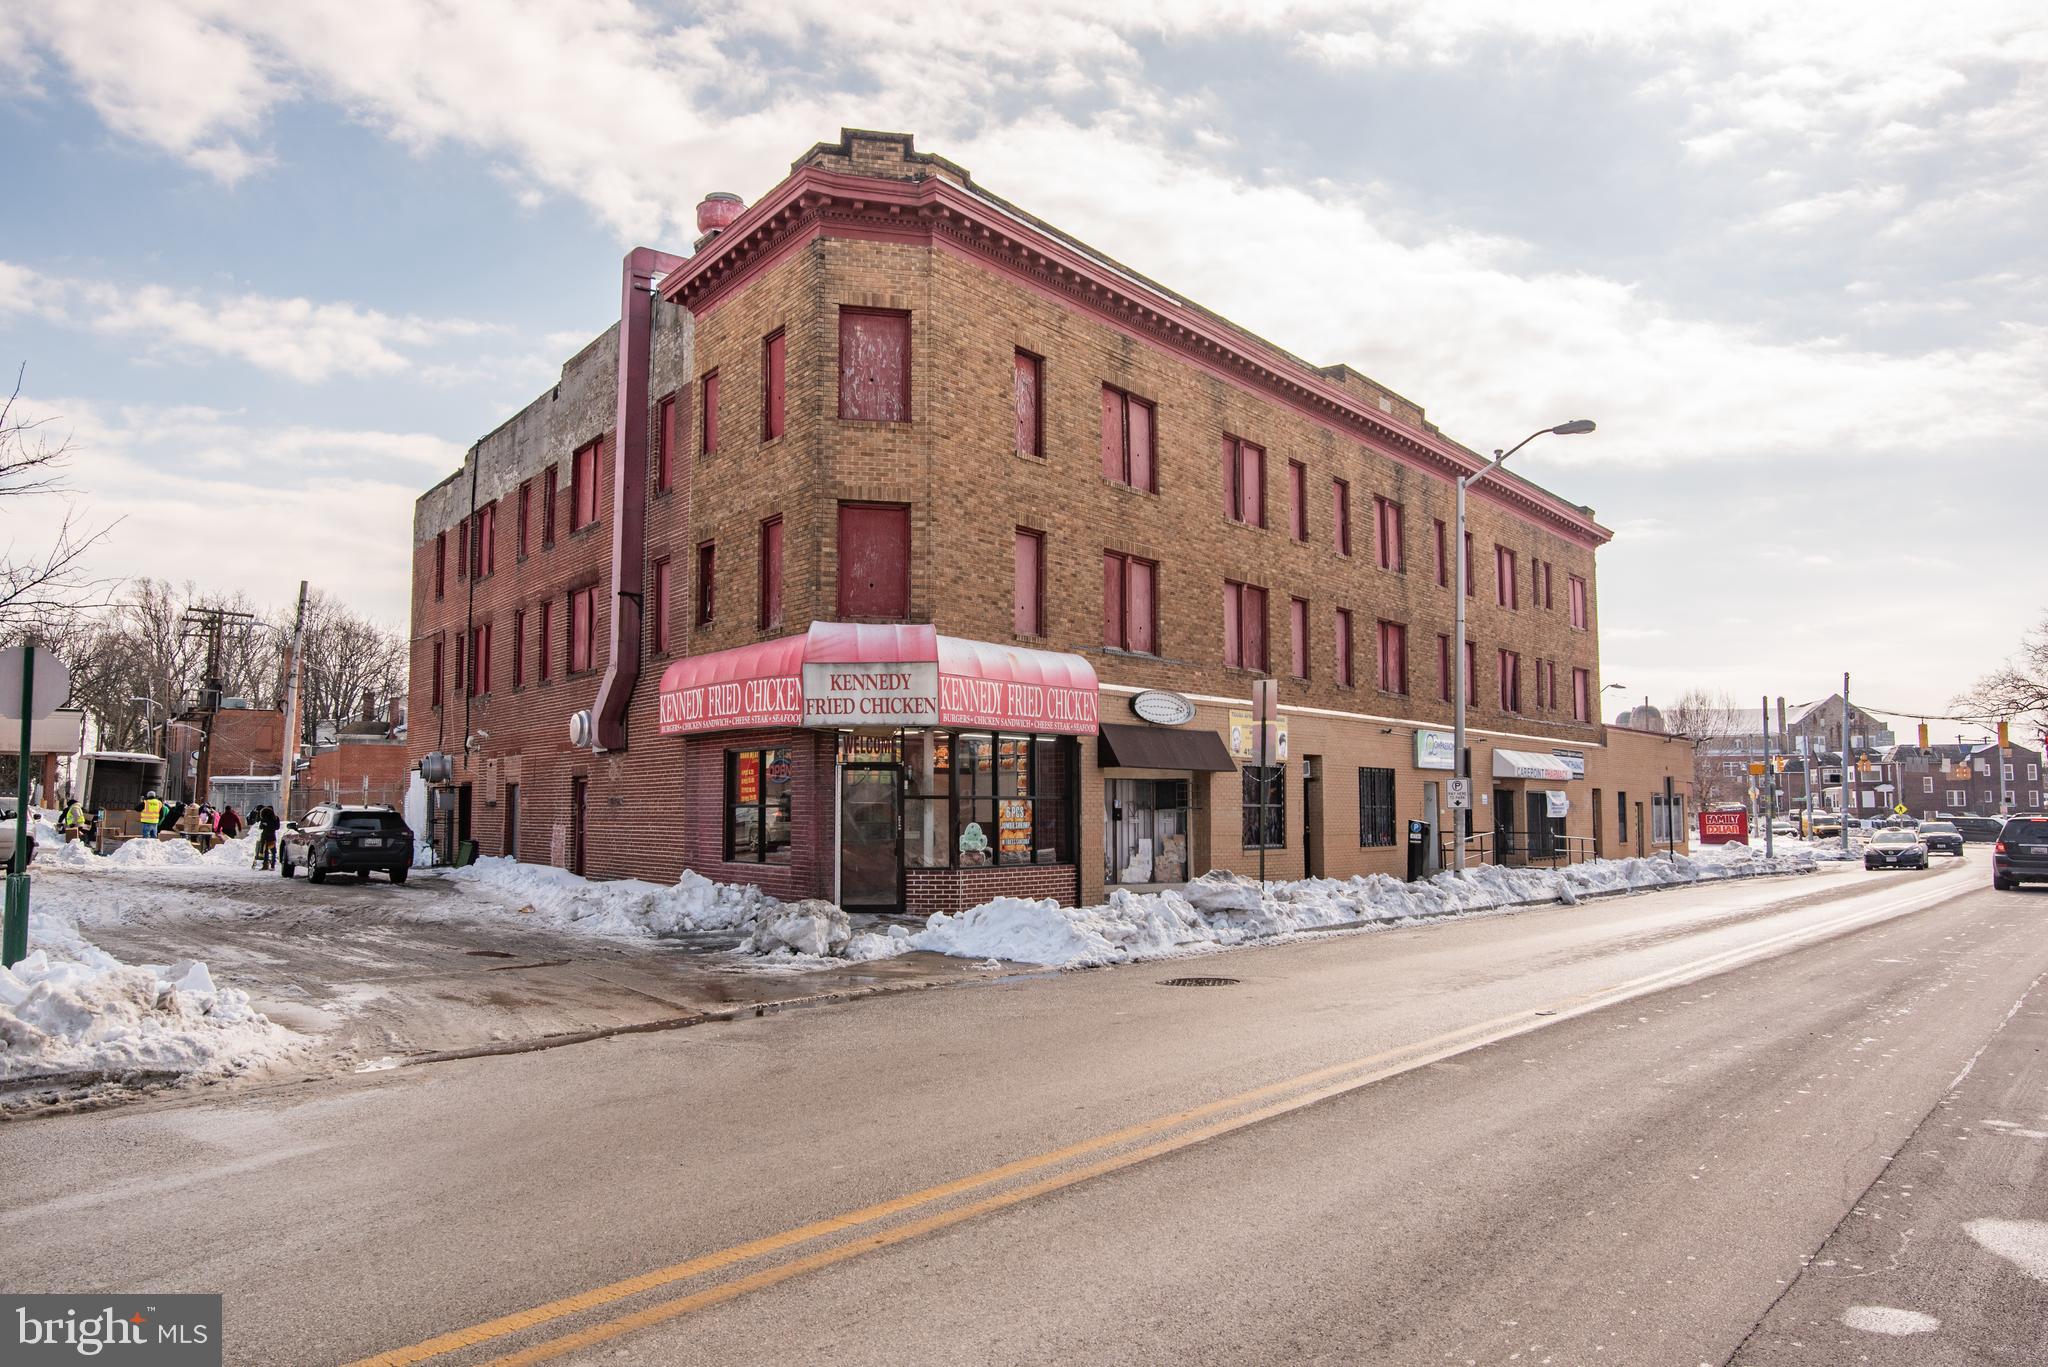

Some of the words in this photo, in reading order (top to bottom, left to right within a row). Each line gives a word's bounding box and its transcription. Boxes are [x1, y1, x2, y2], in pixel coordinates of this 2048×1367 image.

[829, 673, 912, 691] KENNEDY
[660, 688, 704, 723] KENNEDY
[708, 683, 741, 717] FRIED
[806, 697, 855, 715] FRIED
[860, 697, 936, 714] CHICKEN
[940, 676, 1003, 714] KENNEDY
[1007, 683, 1043, 717] FRIED
[1047, 688, 1098, 721] CHICKEN
[682, 720, 703, 731] CHICKEN
[702, 717, 729, 729] SANDWICH
[731, 715, 750, 726] CHEESE
[751, 714, 769, 724] STEAK
[943, 713, 971, 724] BURGERS
[973, 715, 1000, 727] CHICKEN
[1000, 718, 1031, 728] SANDWICH
[1034, 720, 1053, 730] CHEESE
[1054, 721, 1071, 731] STEAK
[1073, 723, 1097, 733] SEAFOOD
[1706, 814, 1739, 824] FAMILY
